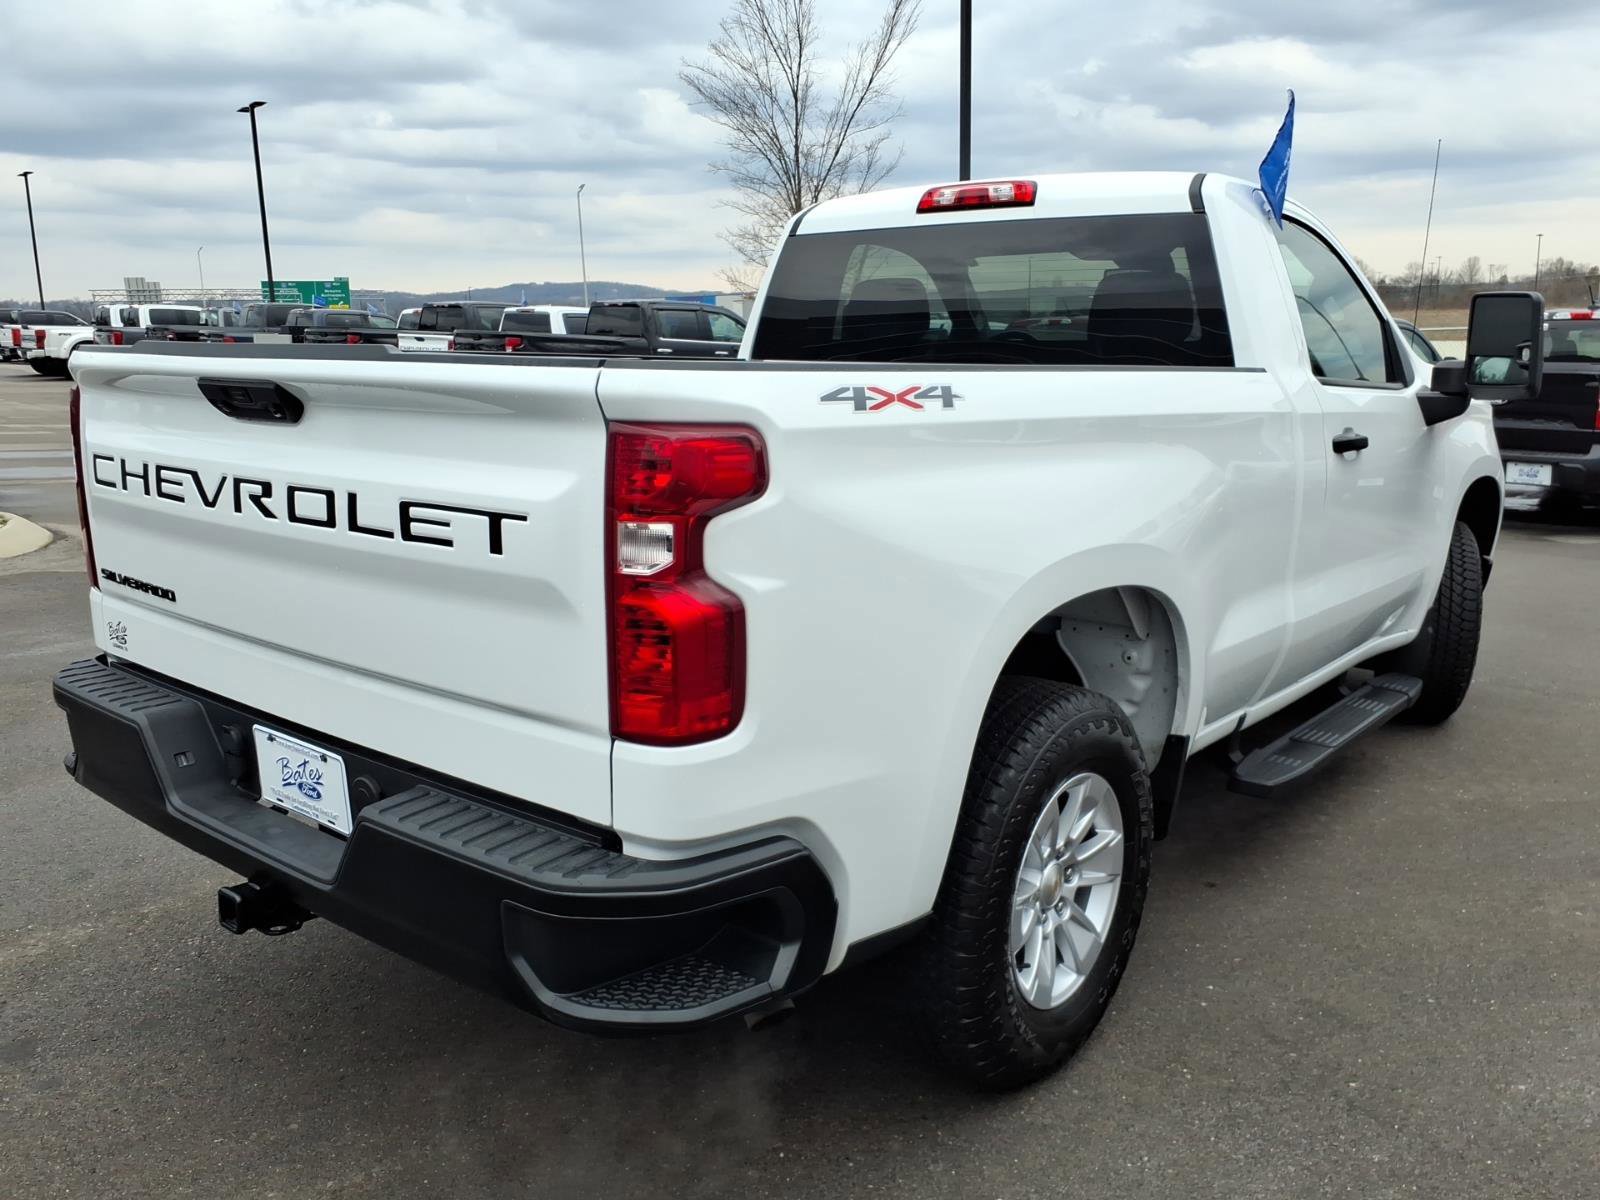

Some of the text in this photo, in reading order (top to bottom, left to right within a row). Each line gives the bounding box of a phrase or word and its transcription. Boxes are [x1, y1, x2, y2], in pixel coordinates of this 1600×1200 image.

[93, 454, 528, 556] CHEVROLET
[101, 567, 177, 603] SILVERADO
[276, 757, 323, 781] Bates
[301, 784, 319, 799] Ford
